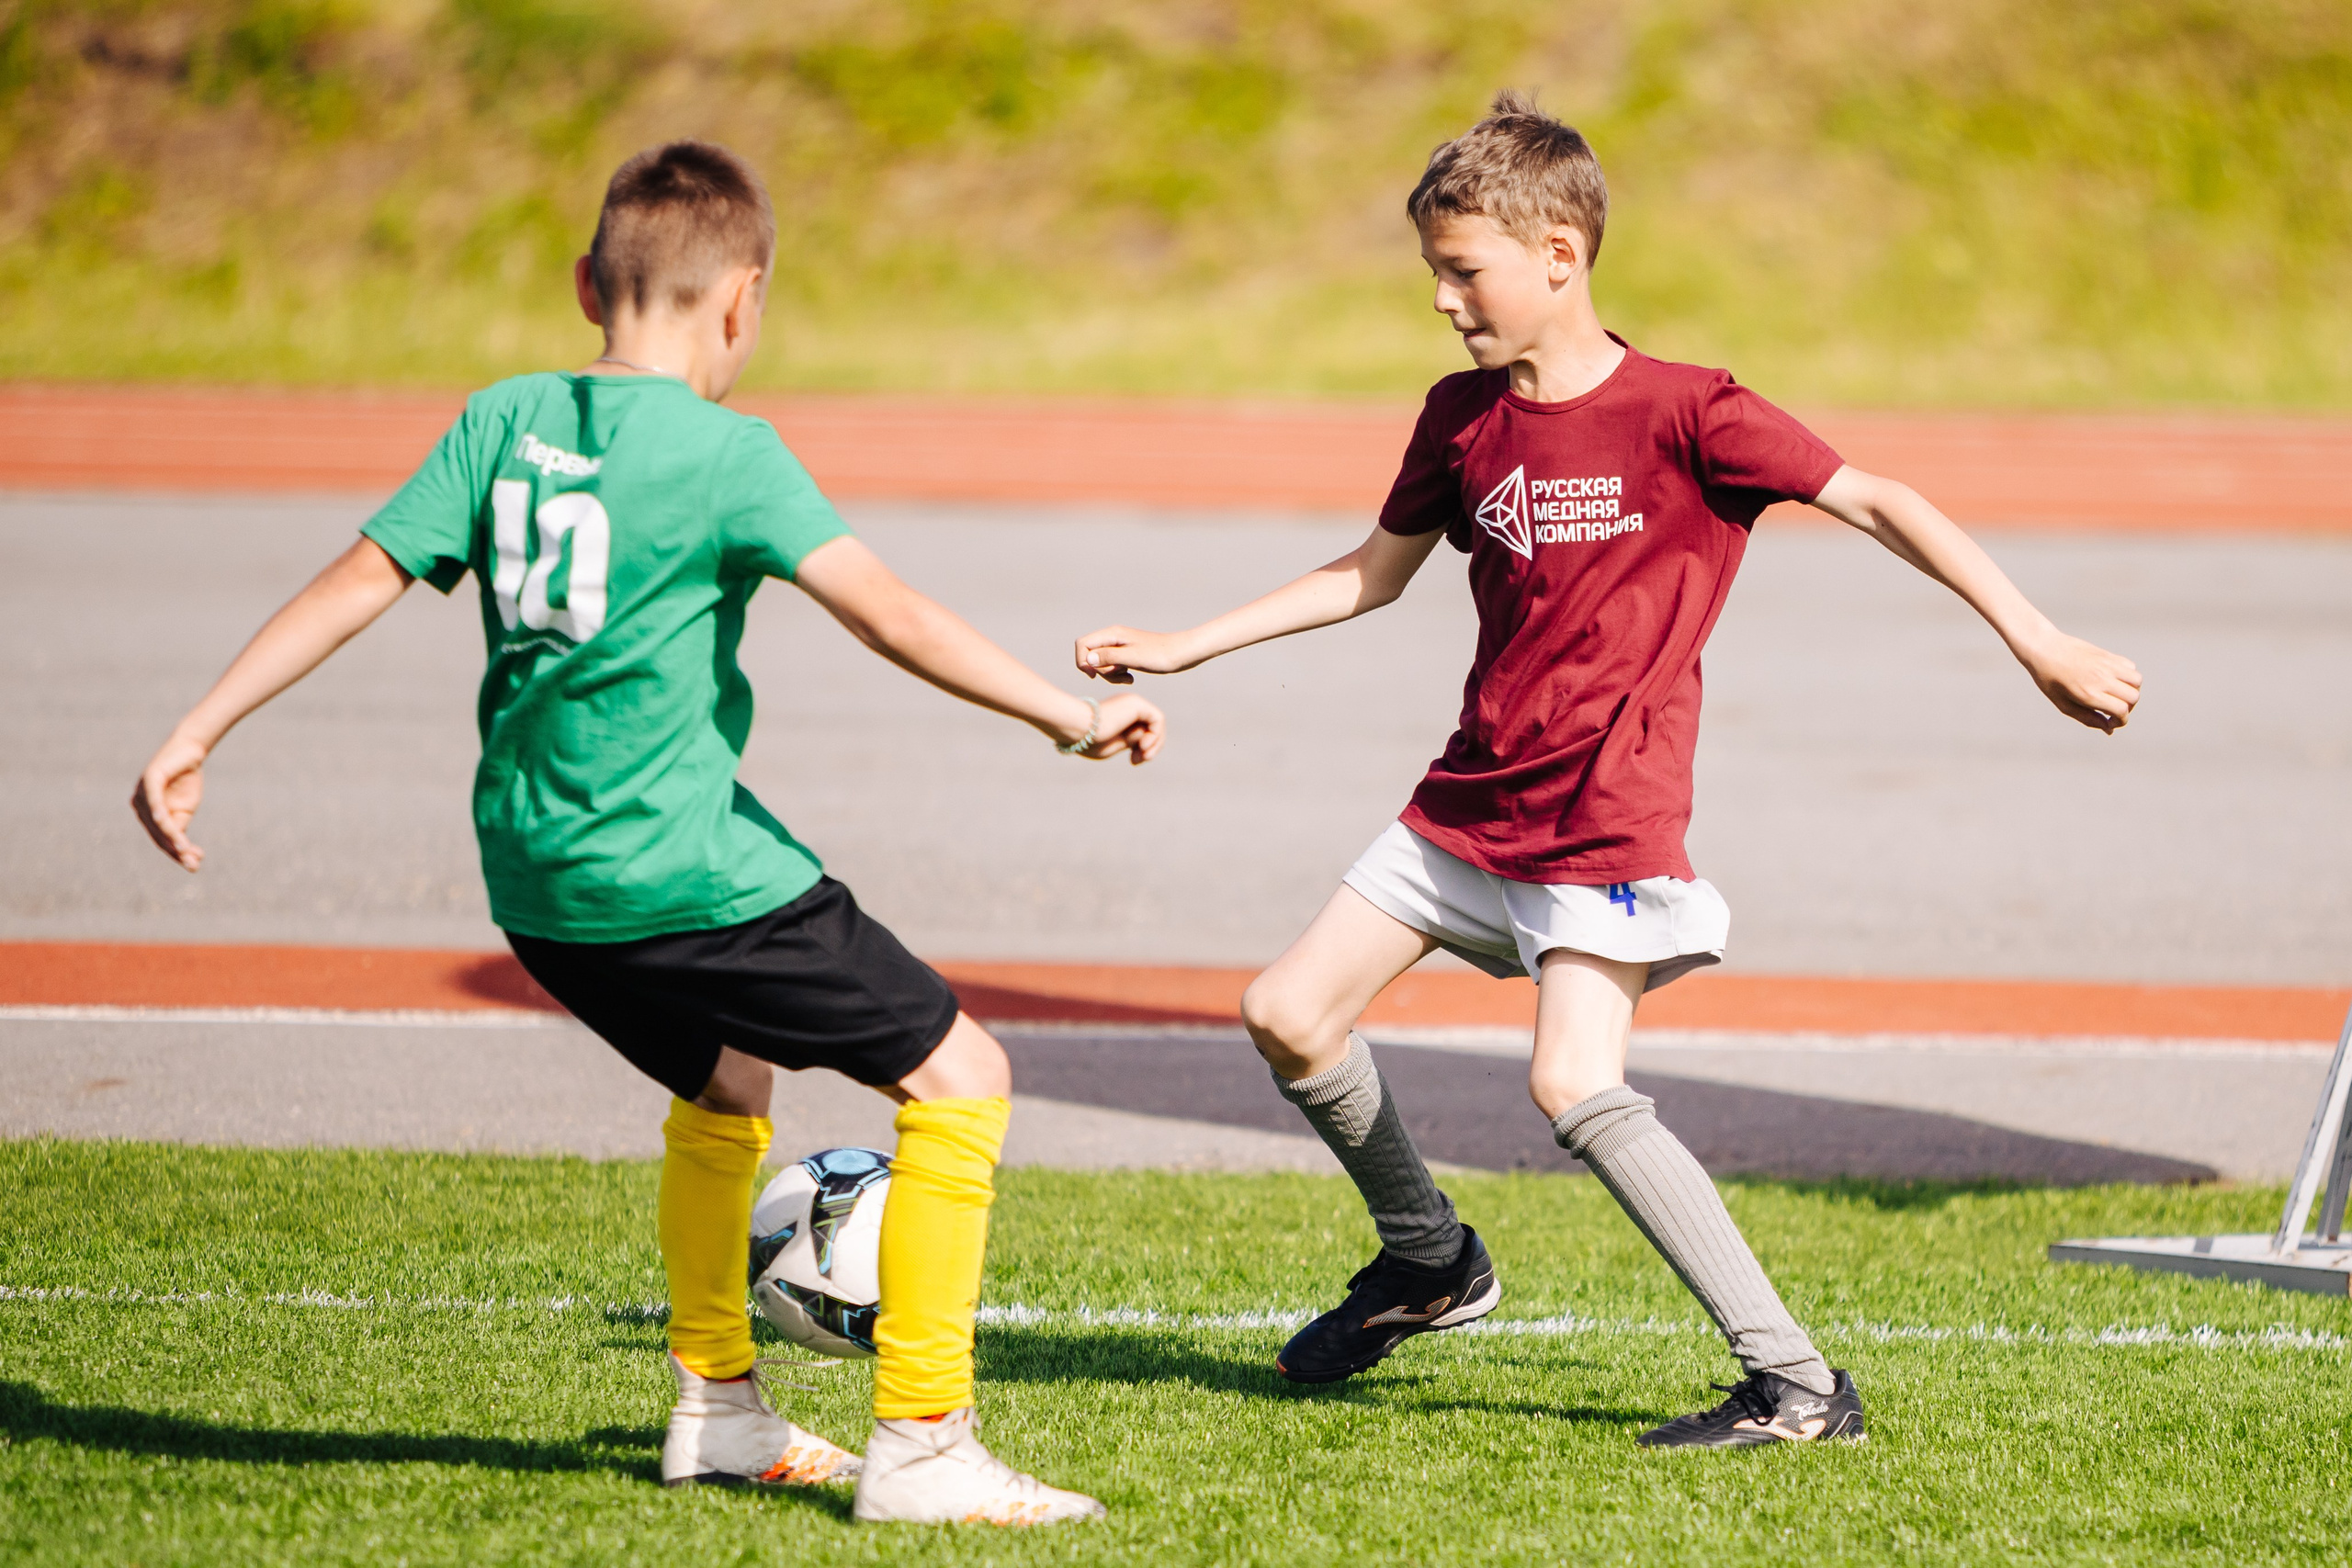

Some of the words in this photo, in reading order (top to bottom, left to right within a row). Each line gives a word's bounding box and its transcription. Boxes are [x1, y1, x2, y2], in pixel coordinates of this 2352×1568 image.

[1531, 477, 1623, 500] РУССКАЯ
[1533, 499, 1620, 522] МЕДНАЯ
[1535, 513, 1644, 544] КОМПАНИЯ
[492, 479, 610, 644] 10
[1610, 882, 1637, 917] 4
[1791, 1401, 1829, 1421] Toledo
